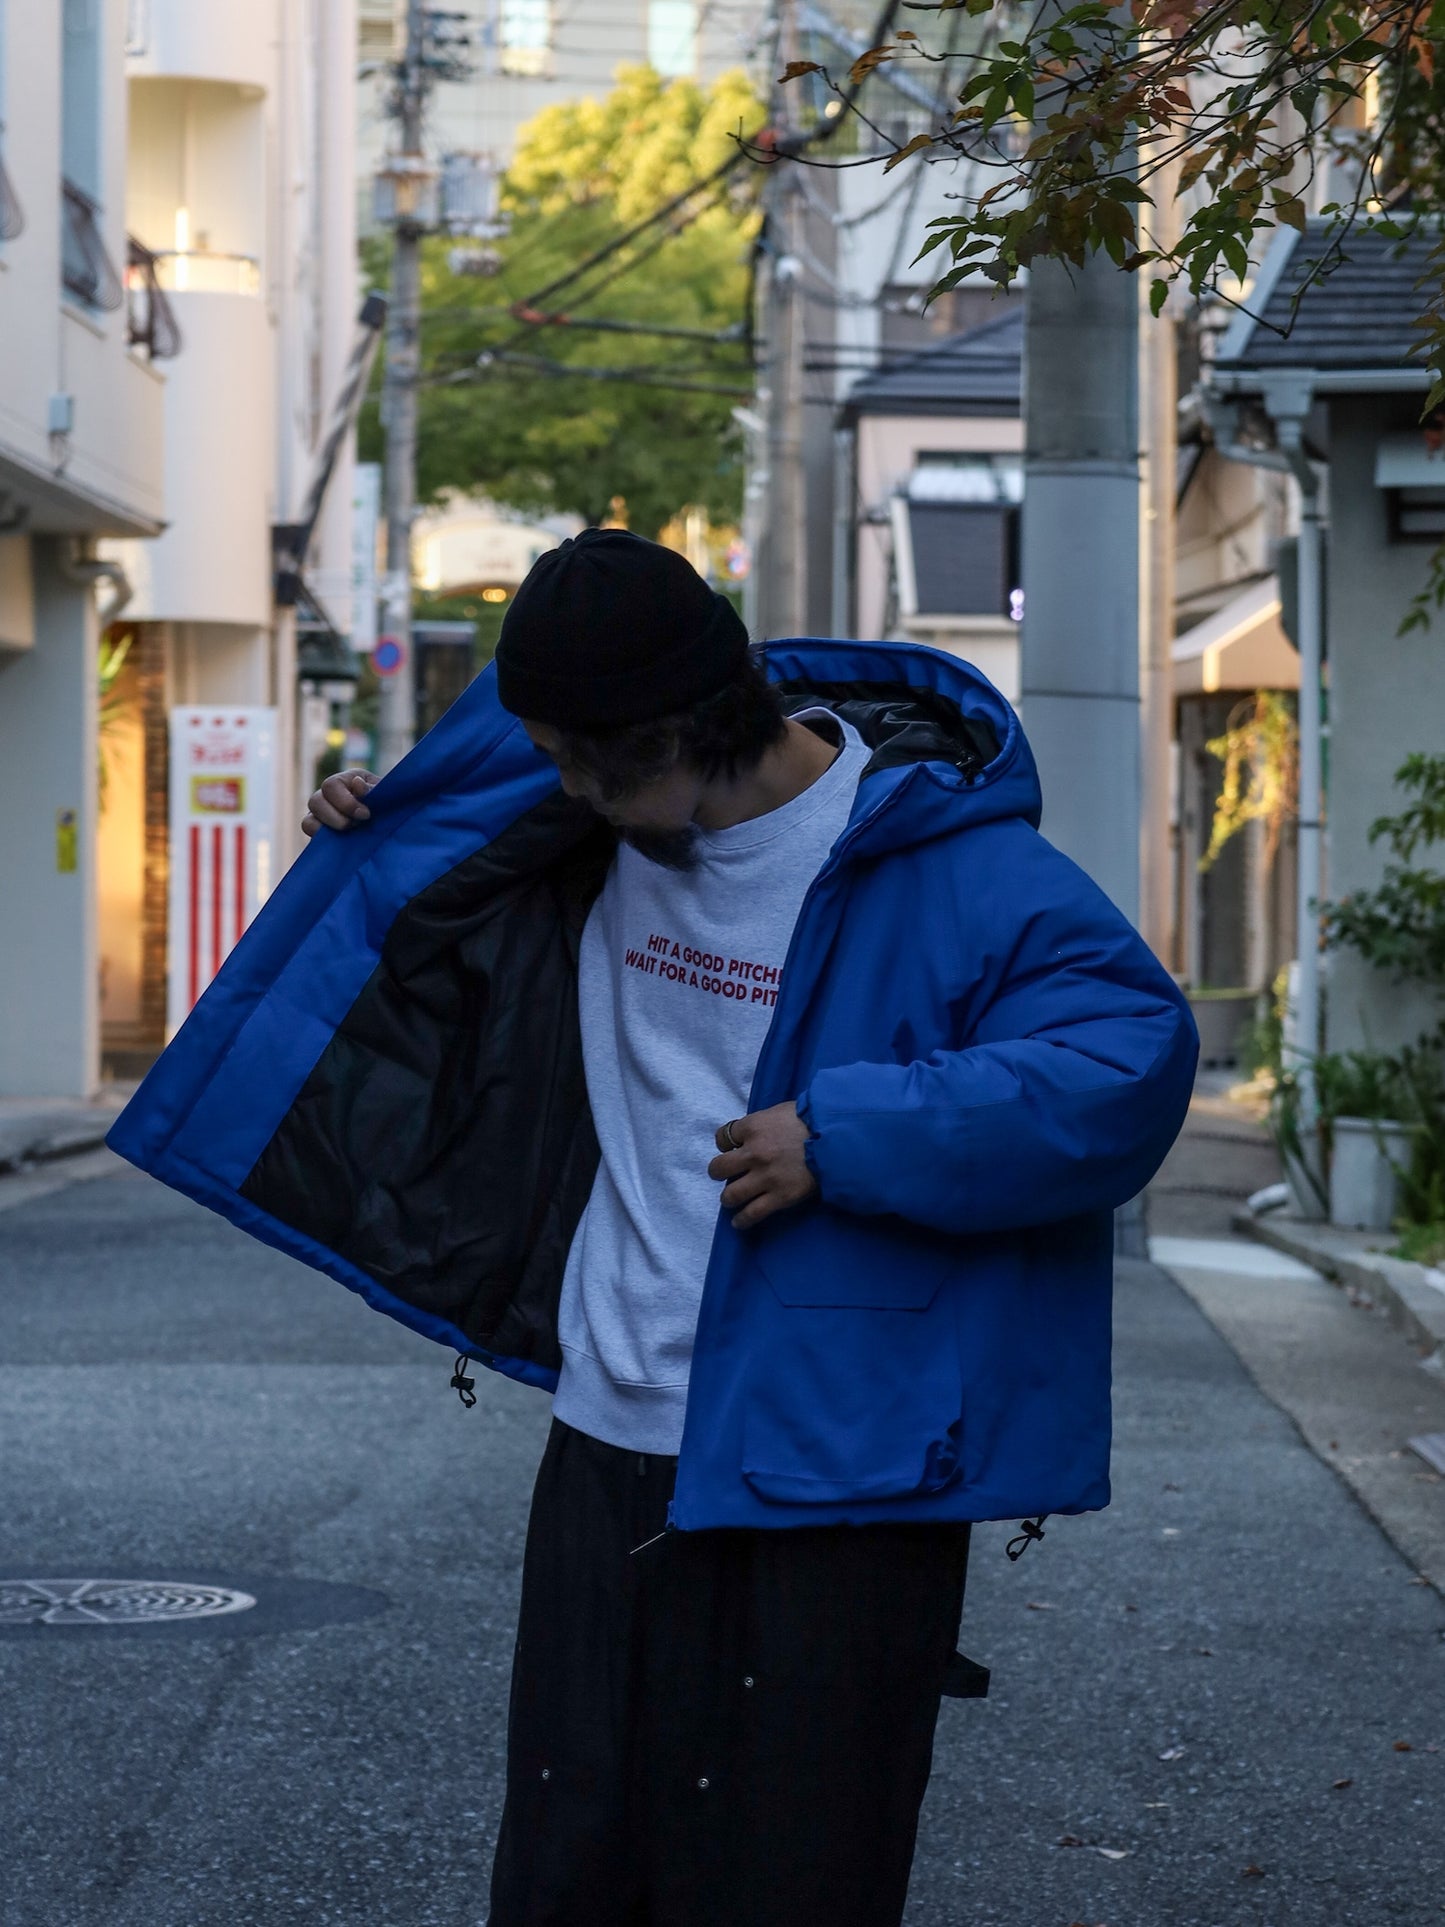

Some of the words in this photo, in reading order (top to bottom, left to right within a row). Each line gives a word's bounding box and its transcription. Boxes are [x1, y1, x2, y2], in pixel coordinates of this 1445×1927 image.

[625, 949, 657, 974] WAIT
[659, 960, 686, 985] FOR
[689, 971, 699, 989] A
[701, 975, 747, 1001] GOOD
[648, 934, 671, 955] HIT
[670, 942, 680, 960] A
[683, 947, 725, 973] GOOD
